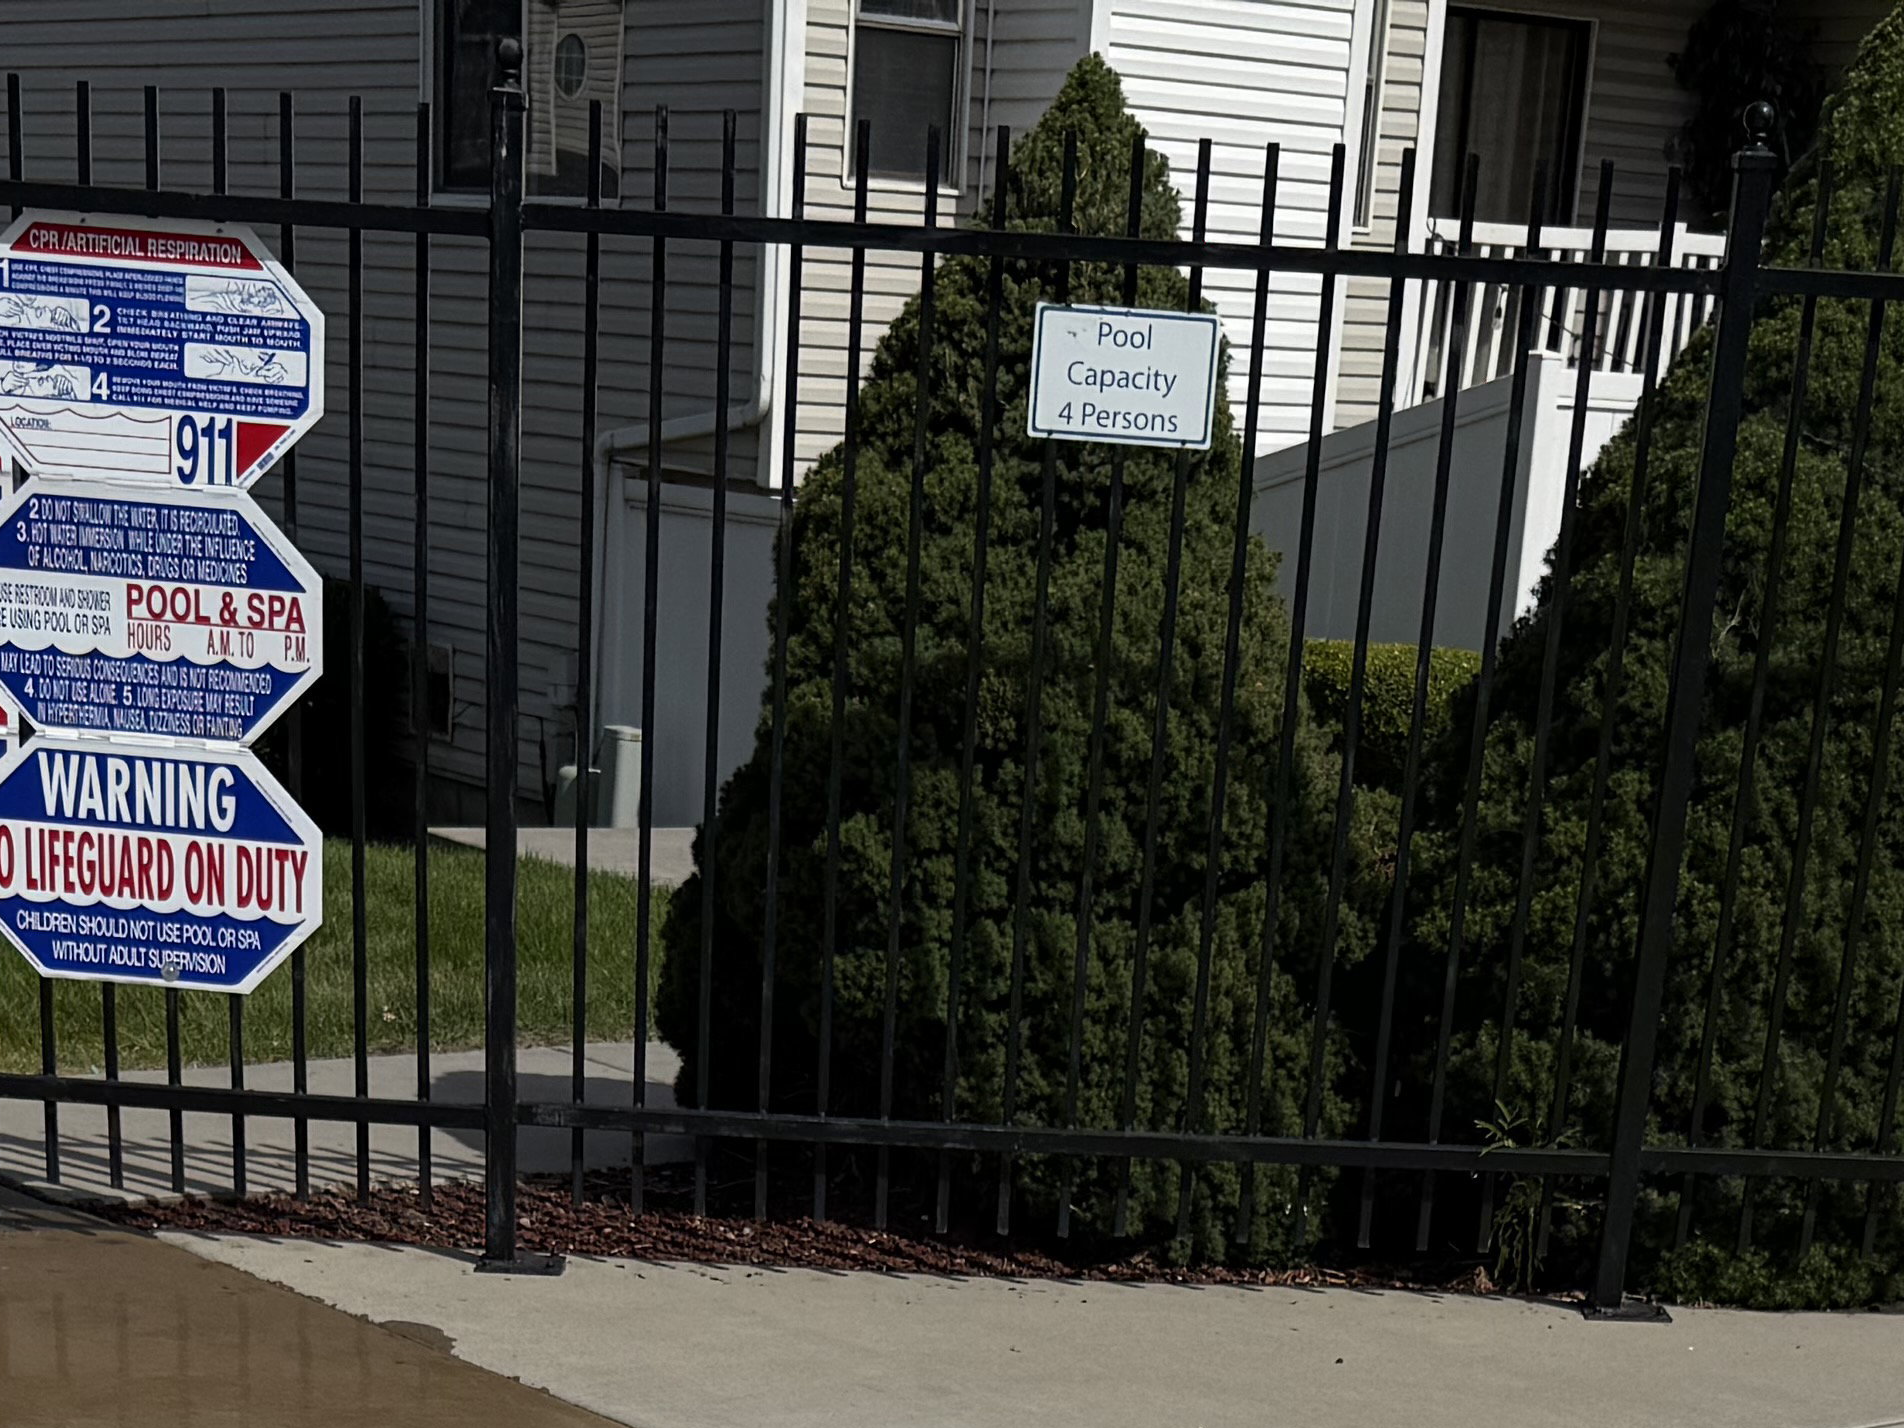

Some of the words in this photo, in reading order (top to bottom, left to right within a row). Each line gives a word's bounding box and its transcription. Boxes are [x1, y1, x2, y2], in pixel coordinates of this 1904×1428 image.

[148, 239, 241, 264] RESPIRATION
[93, 305, 111, 333] 2
[1098, 322, 1152, 350] Pool
[92, 373, 110, 400] 4
[1067, 361, 1177, 398] Capacity
[1058, 402, 1073, 425] 4
[1082, 402, 1178, 433] Persons
[177, 415, 233, 485] 911
[42, 499, 51, 520] DO
[54, 501, 70, 522] NOT
[73, 502, 112, 526] SWALLOW
[114, 506, 128, 526] THE
[160, 510, 168, 529] IT
[170, 511, 177, 530] IS
[17, 521, 29, 542] 3.
[31, 523, 48, 544] HOT
[50, 525, 76, 546] WATER
[79, 527, 124, 549] IMMERSION
[129, 531, 154, 552] WHILE
[155, 532, 182, 554] UNDER
[185, 534, 201, 555] THE
[205, 536, 255, 561] INFLUENCE
[28, 546, 40, 566] OF
[148, 556, 179, 578] DRUGS
[181, 559, 195, 580] OR
[198, 560, 247, 584] MEDICINES
[15, 583, 59, 608] RESTROOM
[60, 587, 75, 609] AND
[77, 589, 111, 612] SHOWER
[127, 583, 210, 624] POOL
[220, 591, 238, 625] &
[247, 594, 305, 633] SPA
[10, 607, 41, 630] USING
[44, 610, 72, 633] POOL
[75, 613, 88, 634] OR
[92, 614, 111, 636] SPA
[128, 622, 171, 651] HOURS
[208, 627, 234, 657] A.M.
[239, 632, 254, 658] TO
[285, 635, 310, 663] P.M.
[1, 653, 18, 673] MAY
[20, 654, 40, 675] LEAD
[43, 656, 54, 676] TO
[56, 657, 91, 679] SERIOUS
[94, 660, 159, 684] CONSEQUENCES
[161, 667, 177, 686] AND
[180, 668, 187, 686] IS
[189, 670, 205, 688] NOT
[208, 671, 271, 694] RECOMMENDED
[24, 678, 37, 698] 4.
[39, 681, 51, 699] DO
[53, 682, 70, 701] NOT
[72, 684, 88, 703] USE
[138, 689, 159, 708] LONG
[162, 691, 203, 712] EXPOSURE
[206, 694, 223, 713] MAY
[225, 696, 254, 716] RESULT
[38, 702, 45, 720] IN
[149, 712, 191, 735] DIZZINESS
[193, 716, 205, 735] OR
[207, 717, 242, 738] FAINTING
[38, 751, 236, 833] WARNING
[25, 826, 174, 901] LIFEGUARD
[185, 840, 225, 906] ON
[237, 845, 308, 914] DUTY
[17, 909, 76, 934] CHILDREN
[79, 914, 127, 939] SHOULD
[130, 919, 155, 940] NOT
[158, 923, 180, 943] USE
[183, 925, 216, 947] POOL
[218, 929, 236, 947] OR
[238, 930, 261, 950] SPA
[52, 940, 106, 963] WITHOUT
[109, 944, 145, 966] ADULT
[148, 949, 225, 974] SUPERVISION
